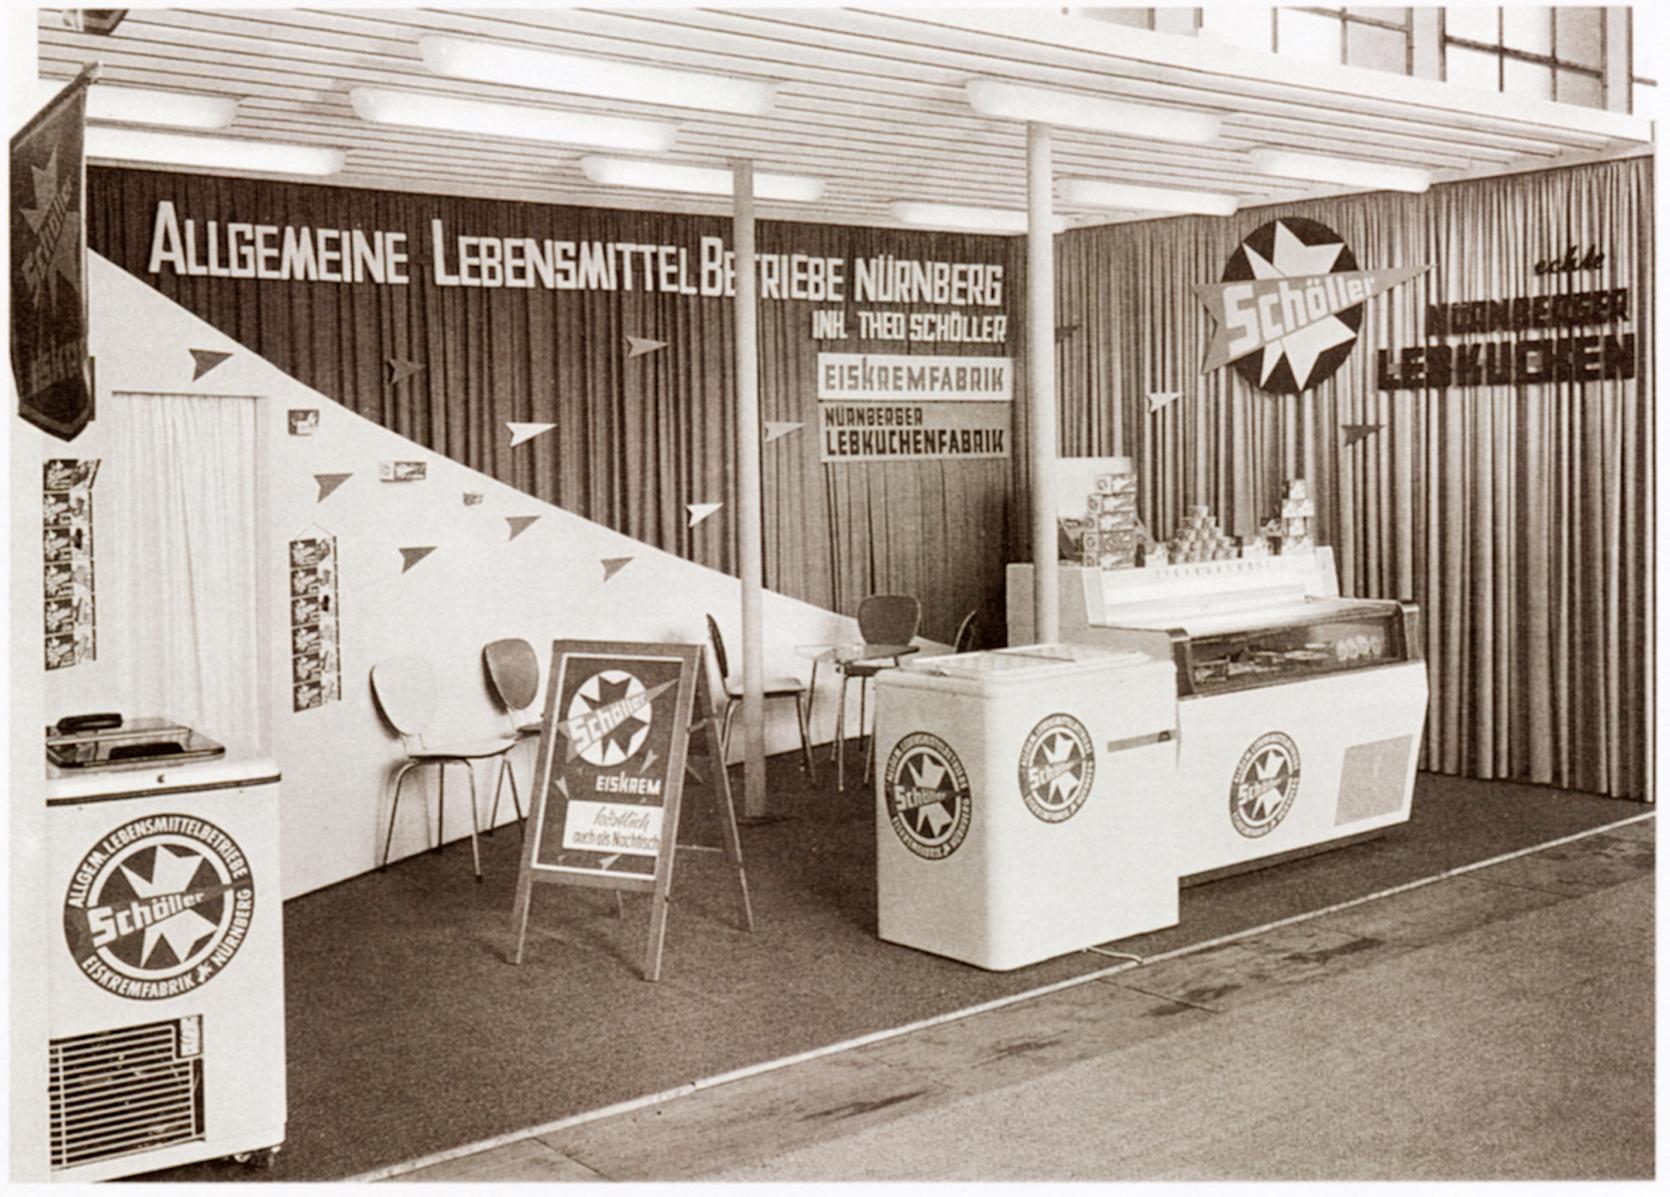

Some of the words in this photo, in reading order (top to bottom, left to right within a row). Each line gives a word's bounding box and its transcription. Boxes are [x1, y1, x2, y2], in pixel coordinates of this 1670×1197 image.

[148, 200, 410, 284] ALLGEMEINE
[855, 254, 1004, 307] NÜRNBERG
[857, 310, 906, 340] THEO
[1221, 274, 1376, 359] Schöller
[1377, 332, 1636, 391] LEBKUCHEN
[825, 429, 1005, 456] LEBKUCHENFABRIK
[103, 816, 249, 880] LEBENSMITTELBETRIEBE
[86, 891, 206, 948] Schöller
[82, 955, 196, 998] EISKREMFABRIK
